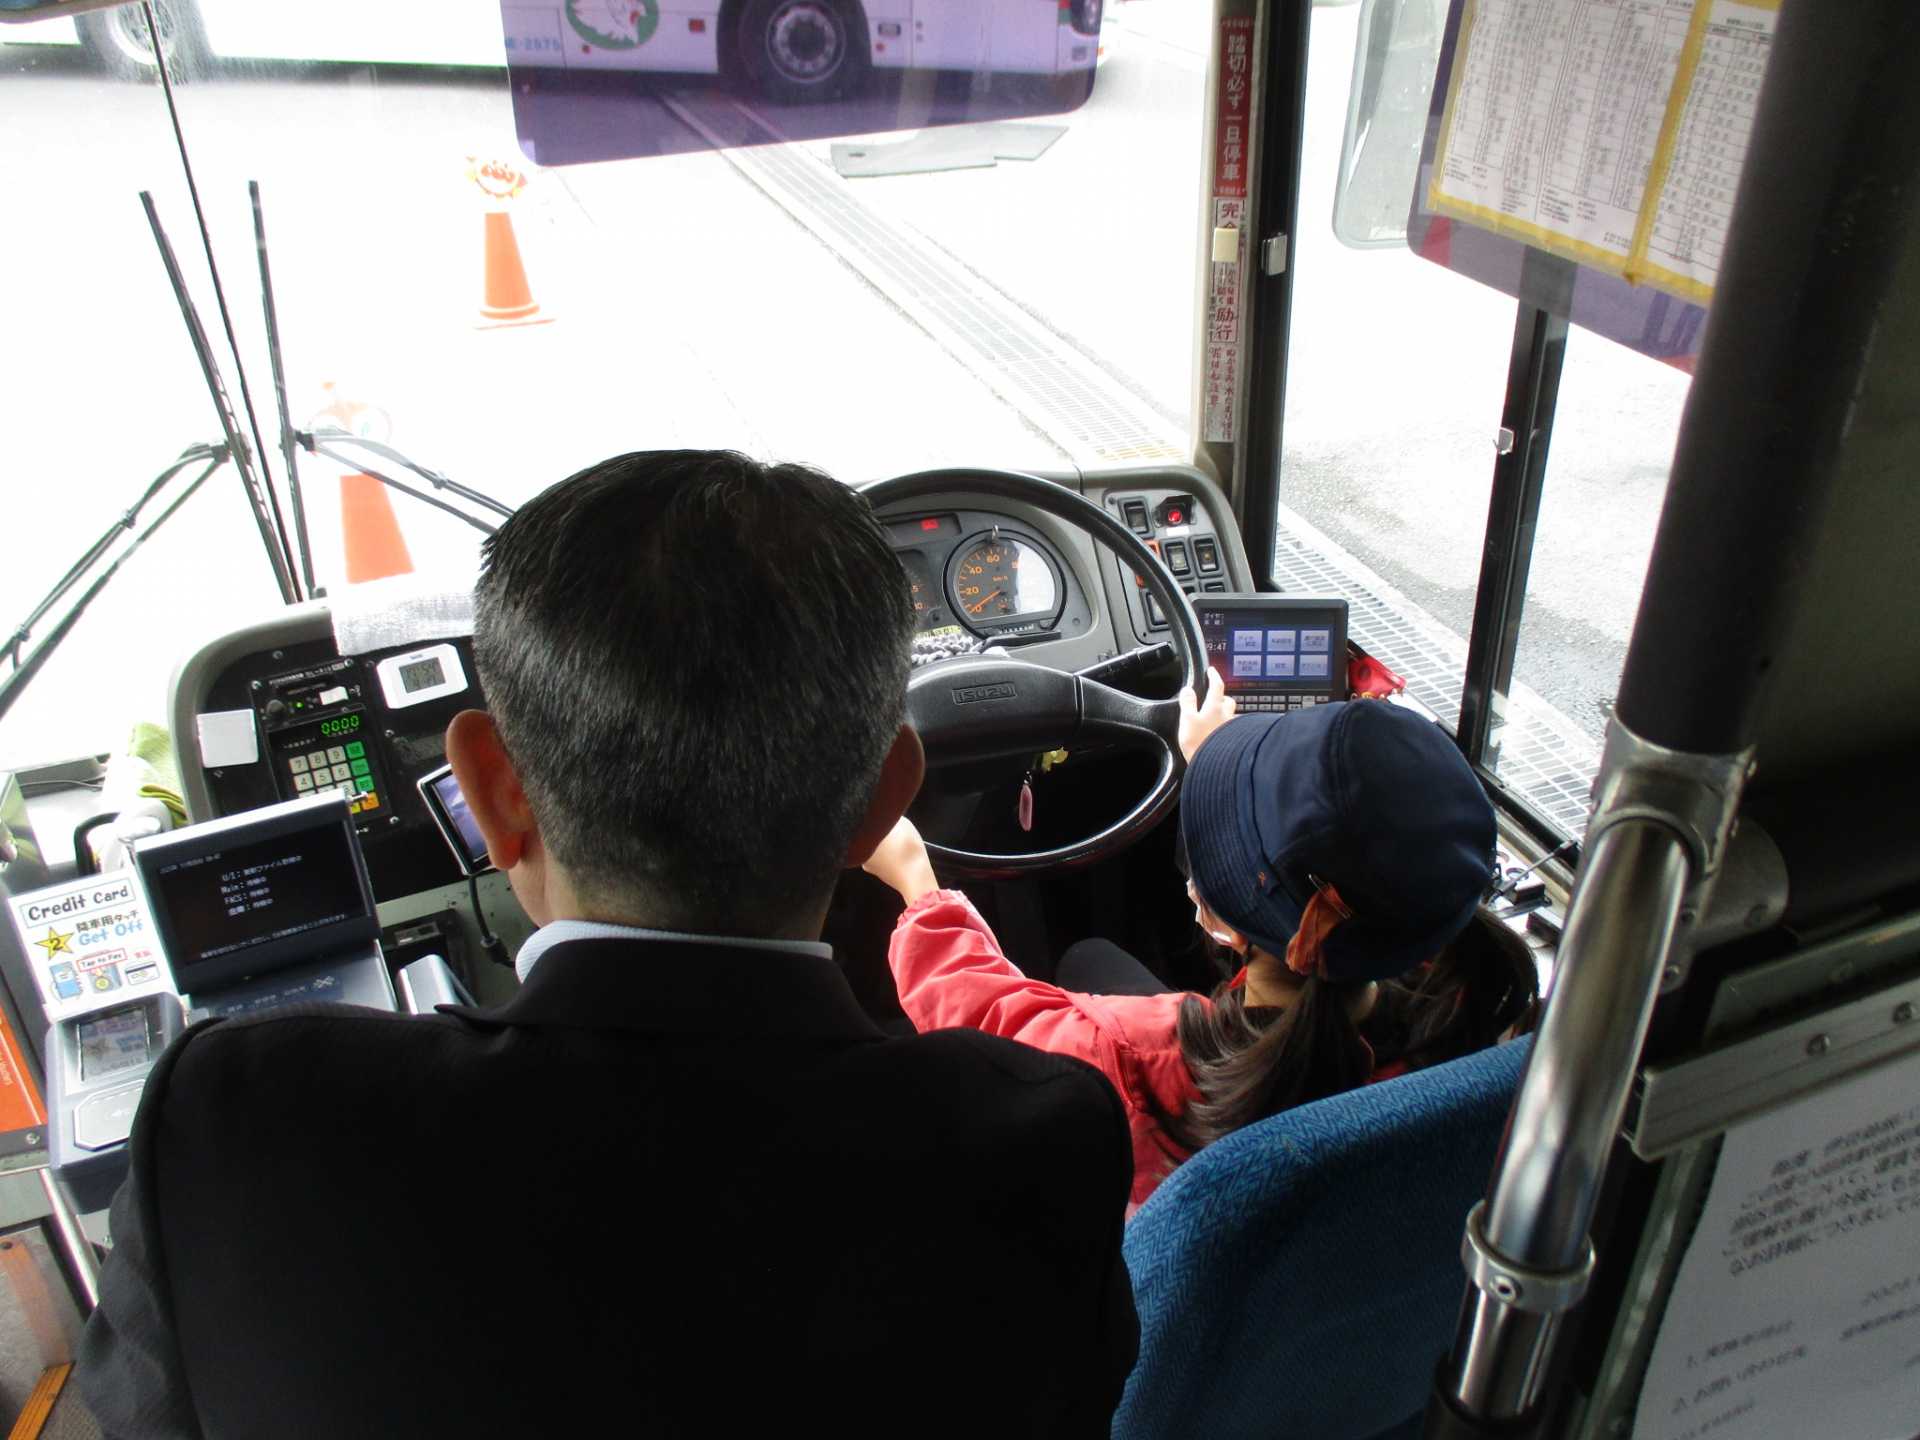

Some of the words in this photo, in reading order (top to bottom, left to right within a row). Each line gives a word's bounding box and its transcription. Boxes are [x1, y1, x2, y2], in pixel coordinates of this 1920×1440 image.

[986, 554, 1000, 564] 60
[969, 566, 982, 575] 40
[966, 586, 979, 595] 20
[321, 715, 360, 735] 0000
[28, 894, 86, 921] Credit
[93, 885, 129, 904] Card
[76, 910, 139, 933] 降車用タッチ
[79, 928, 109, 946] Get
[115, 921, 144, 937] Off
[50, 937, 63, 951] 2
